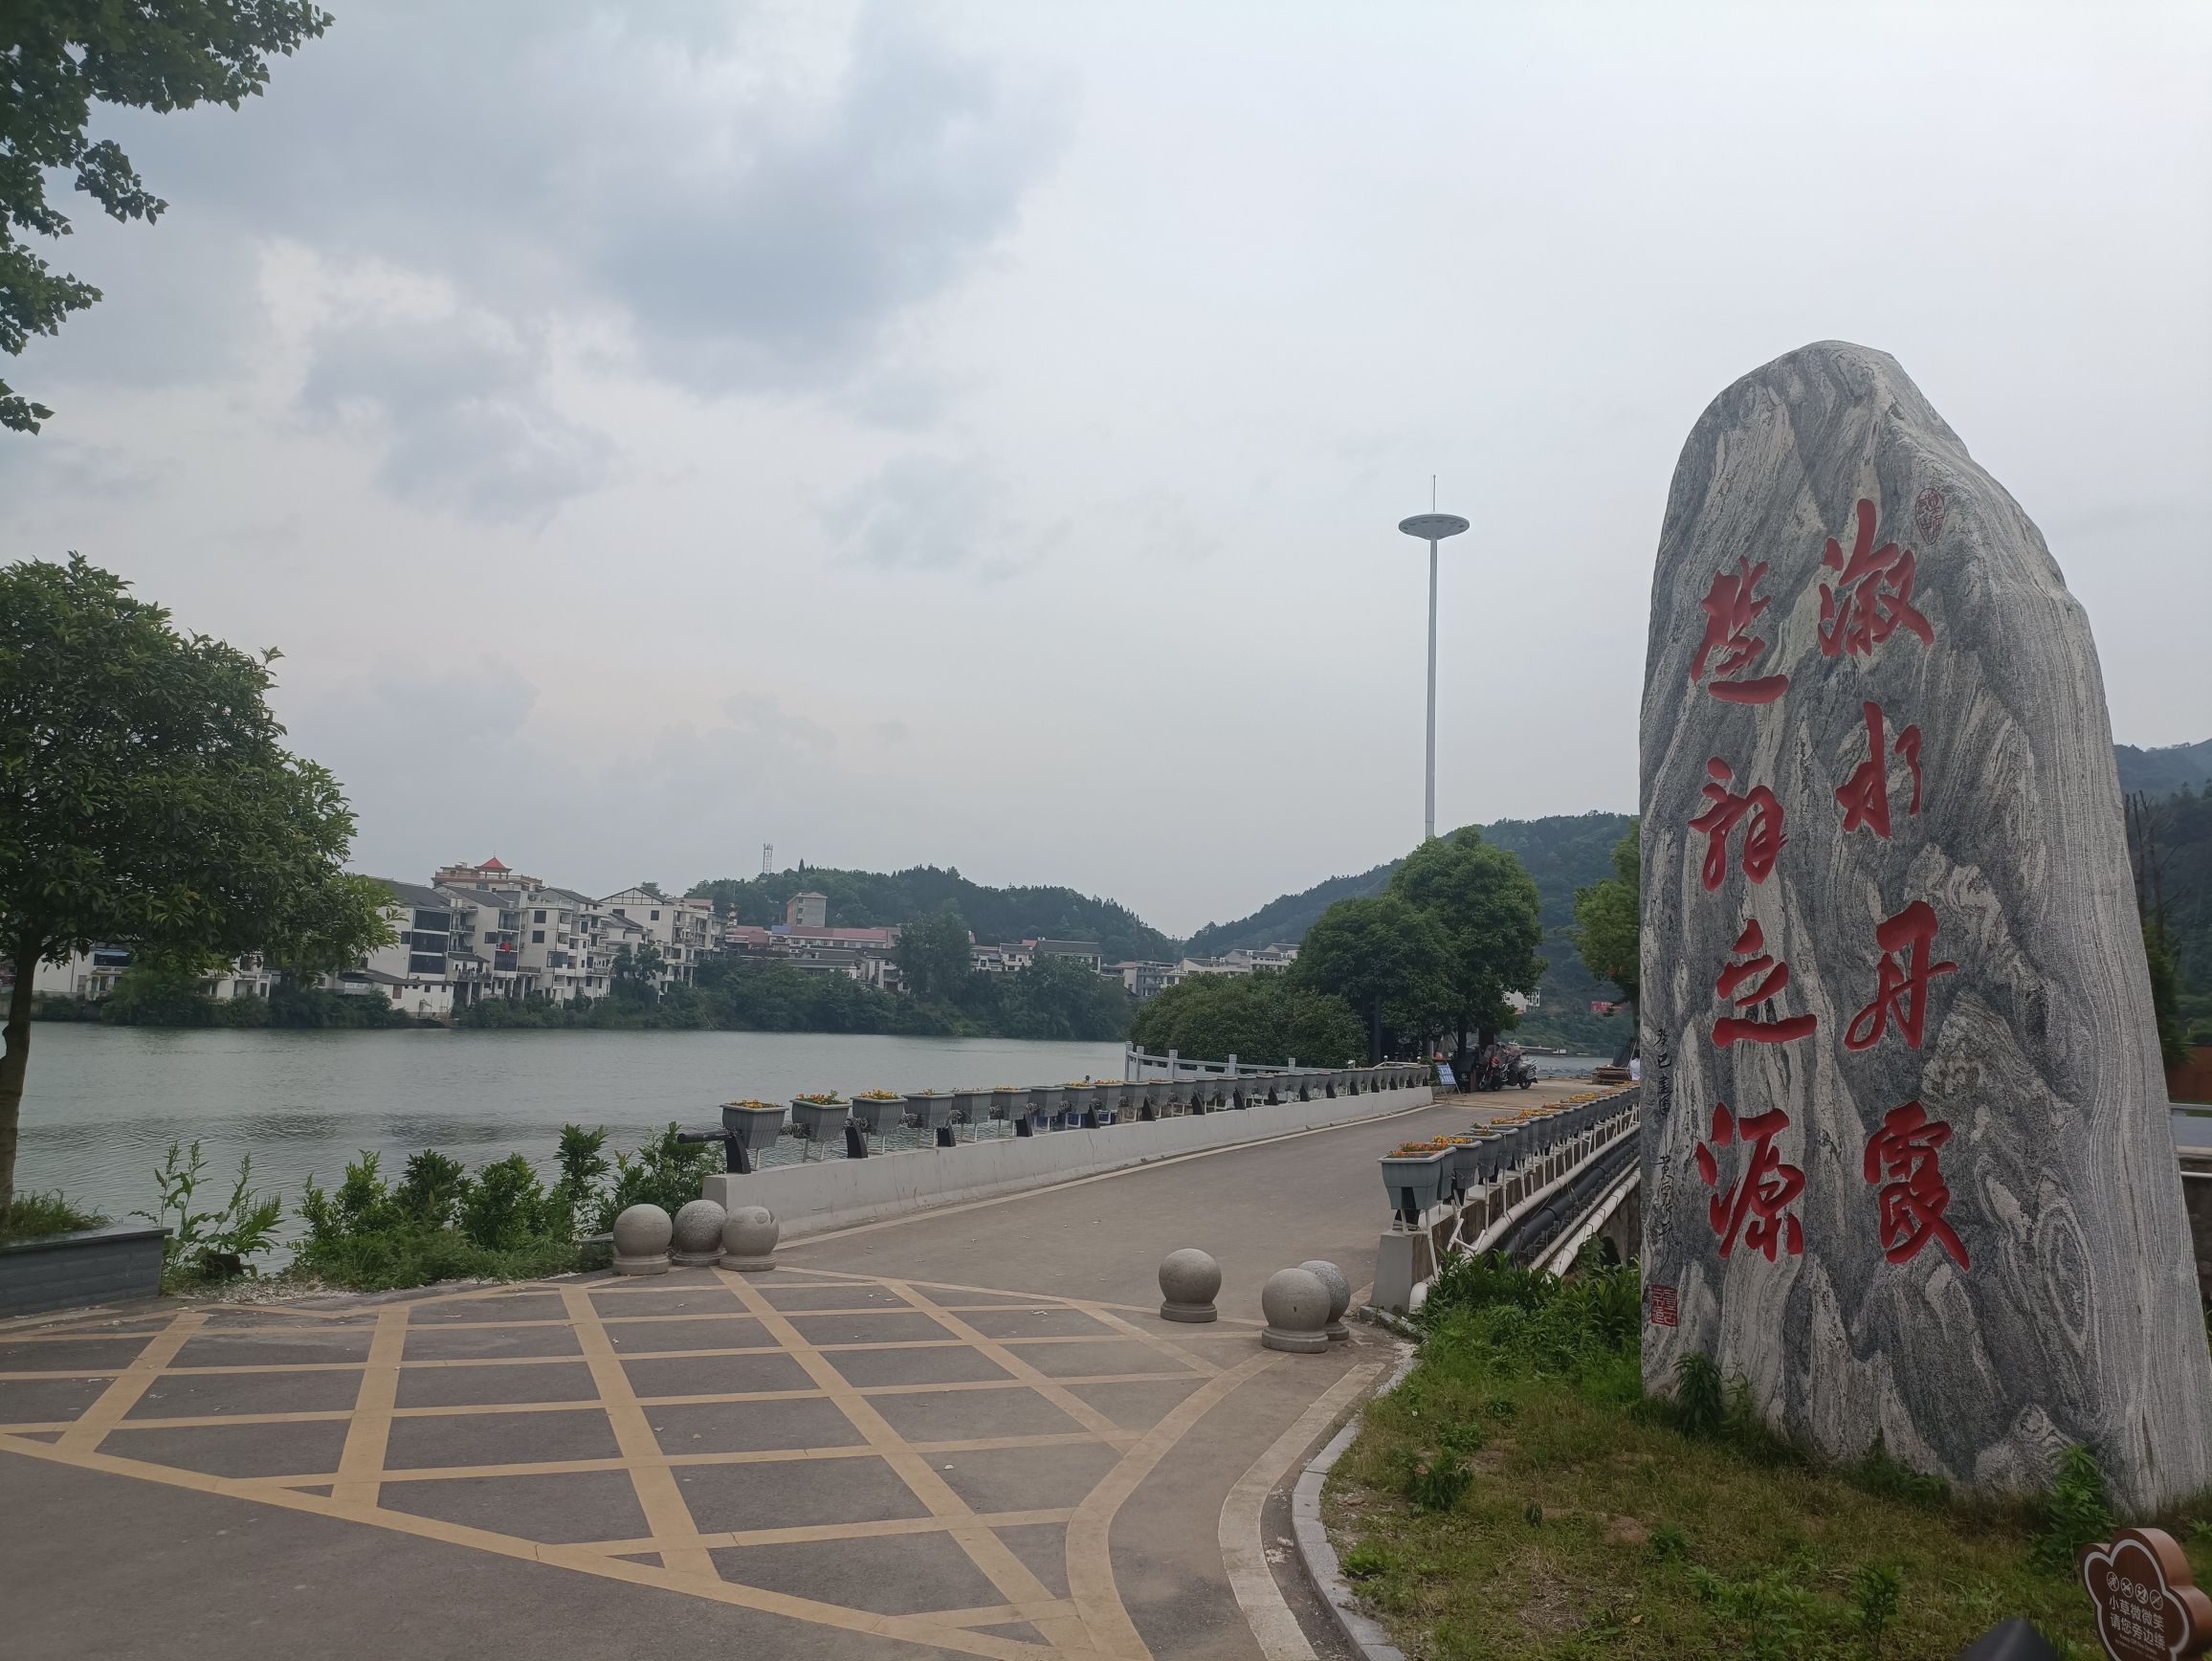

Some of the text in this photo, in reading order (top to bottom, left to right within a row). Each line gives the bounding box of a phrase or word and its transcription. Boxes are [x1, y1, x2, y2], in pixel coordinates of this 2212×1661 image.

[2109, 1595, 2165, 1632] 小草微微笑
[2110, 1612, 2166, 1650] 请您旁边绕
